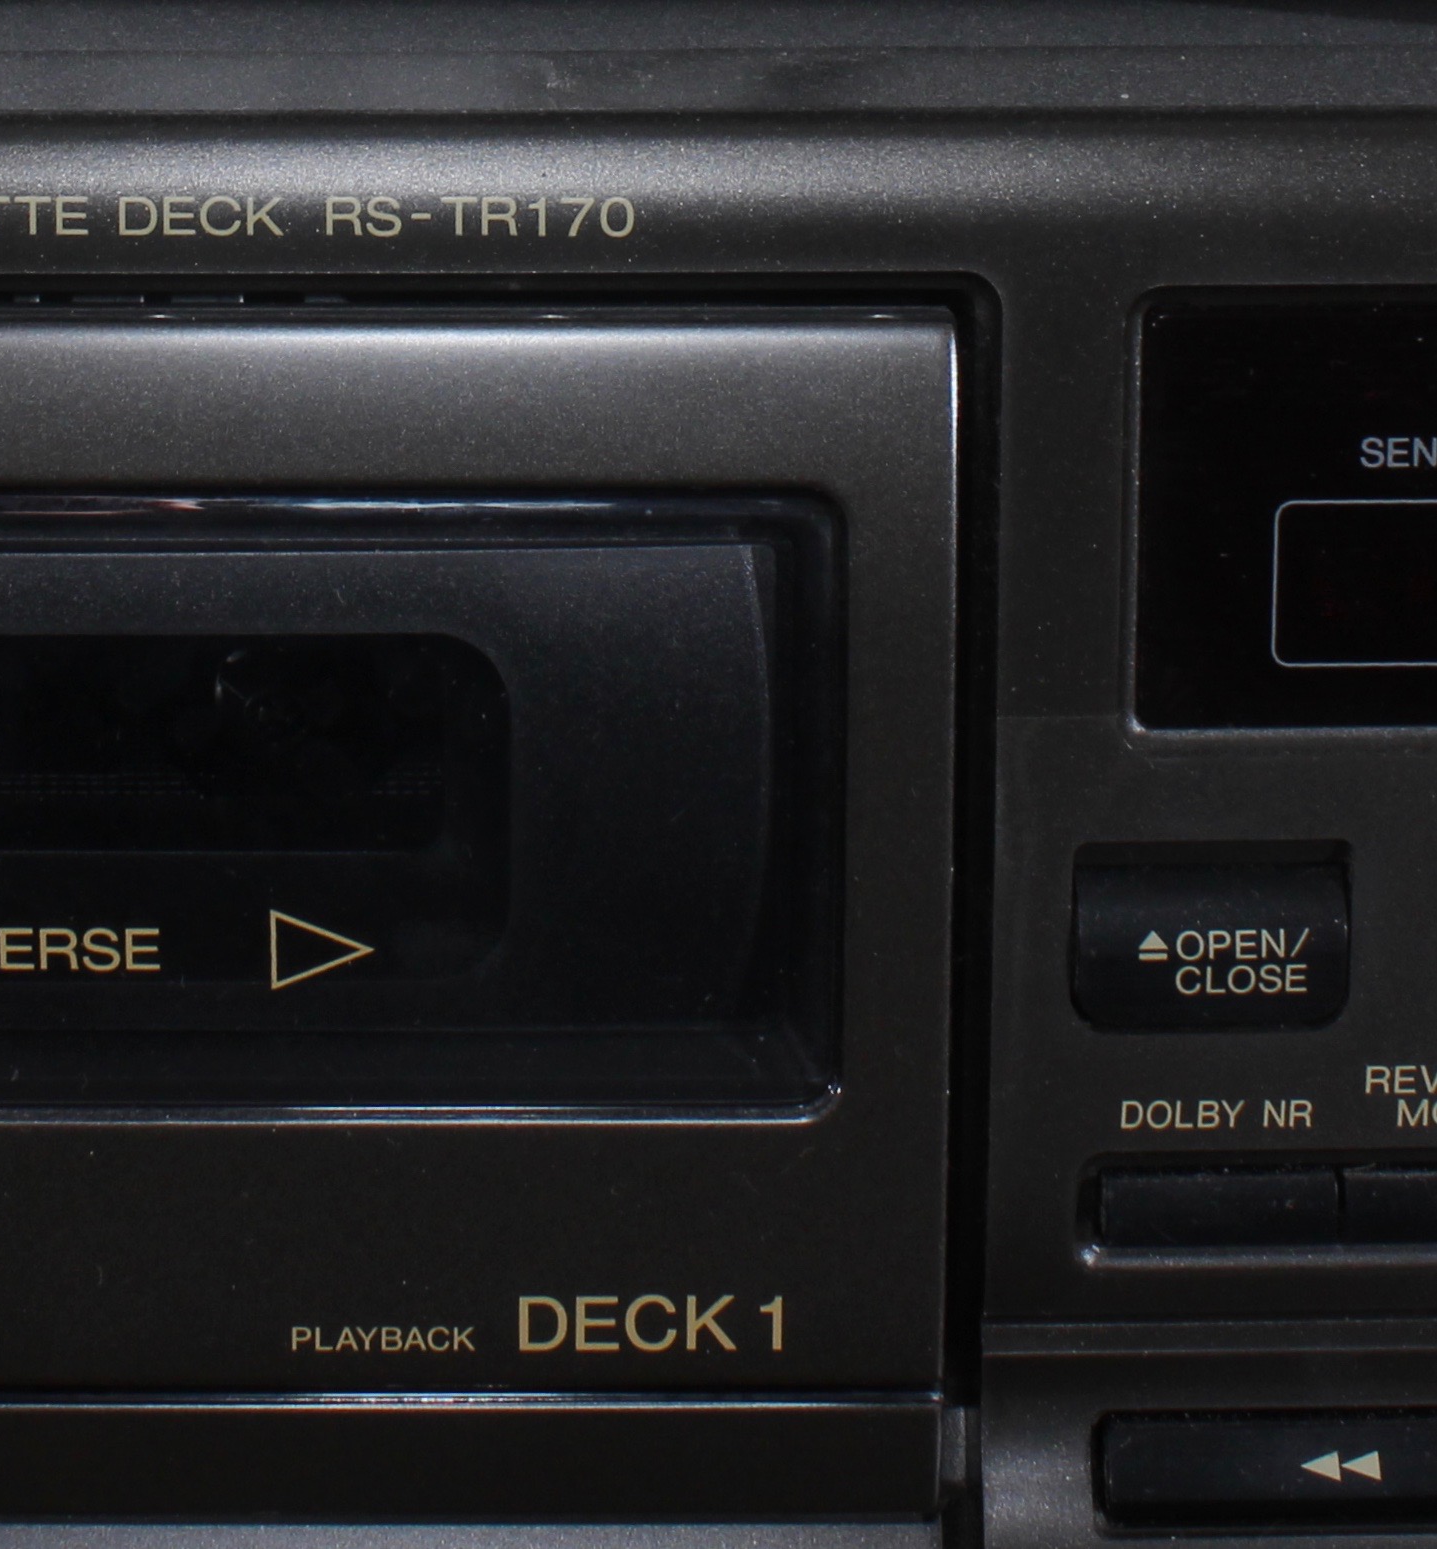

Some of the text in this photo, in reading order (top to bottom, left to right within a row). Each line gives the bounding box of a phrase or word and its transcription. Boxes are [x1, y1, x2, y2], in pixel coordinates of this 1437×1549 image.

[117, 195, 284, 237] DECK
[325, 195, 635, 238] RS-TR170
[1360, 437, 1437, 468] SEN
[1176, 927, 1309, 961] OPEN/
[1175, 963, 1308, 995] CLOSE
[1365, 1065, 1437, 1094] REV
[1120, 1099, 1313, 1130] DOLBY NR
[1397, 1098, 1437, 1127] M
[291, 1294, 783, 1352] PLAYBACK DECK 1
